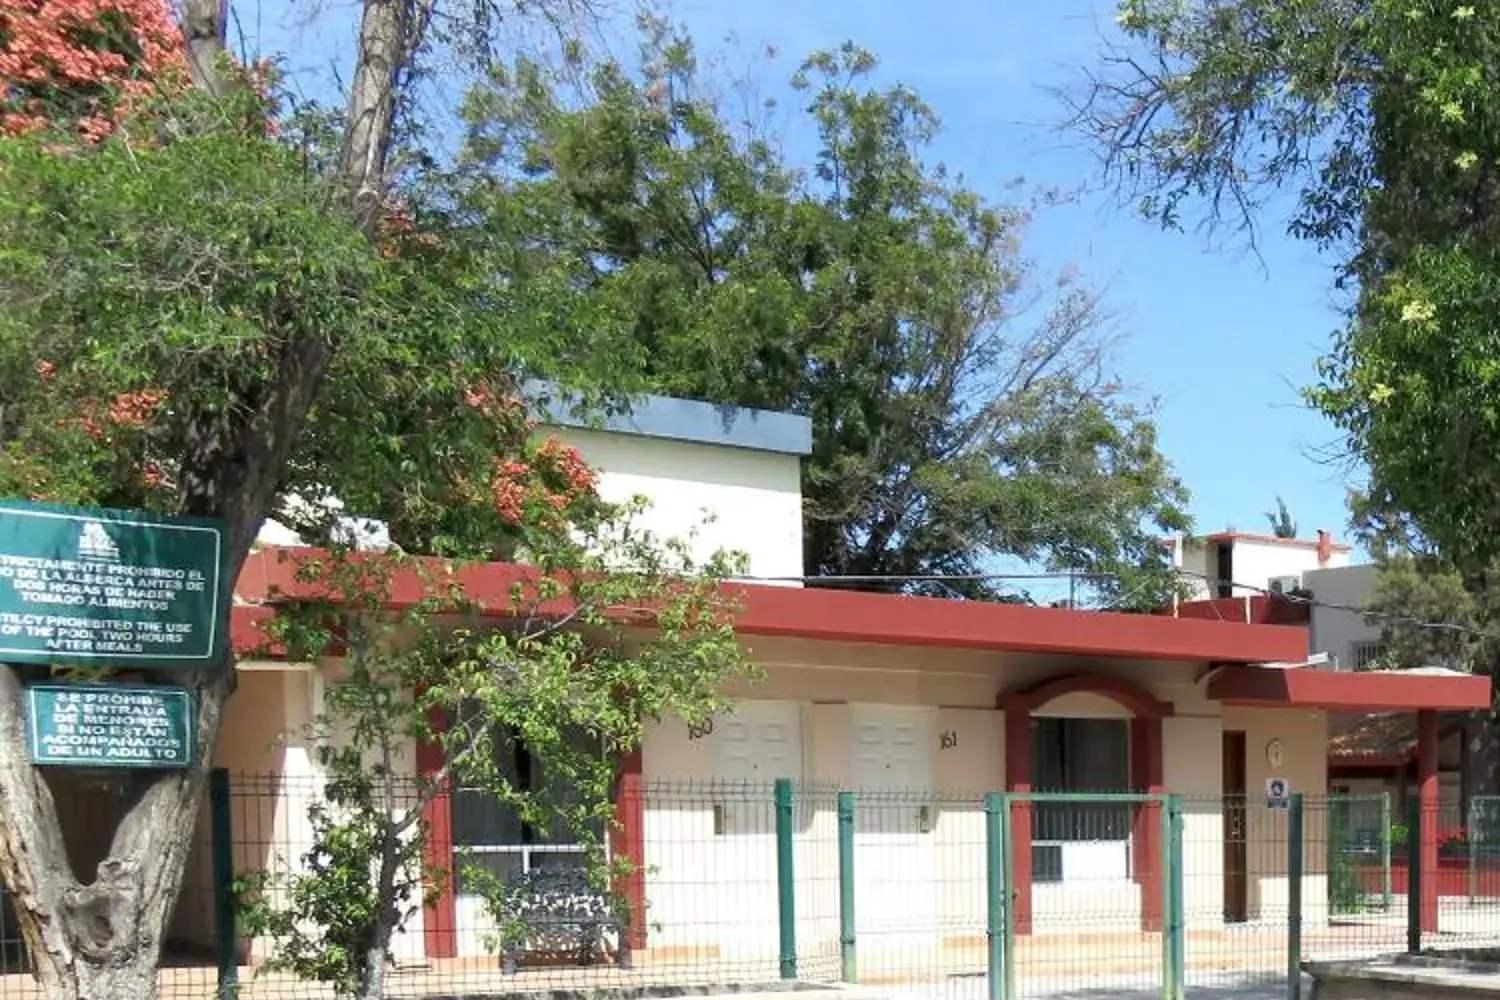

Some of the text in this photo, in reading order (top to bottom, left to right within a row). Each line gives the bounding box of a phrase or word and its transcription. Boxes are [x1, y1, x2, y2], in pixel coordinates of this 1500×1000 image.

[108, 564, 184, 579] PROHIBIDO
[188, 570, 205, 580] EL
[17, 568, 38, 579] DE
[41, 570, 61, 581] LA
[63, 571, 134, 587] ALBERCA
[138, 578, 182, 591] ANTES
[186, 581, 204, 592] DE
[14, 579, 176, 600] DOS HORAS DE HABER
[88, 597, 168, 611] ALIMENTOS
[46, 615, 133, 630] PROHIBITED
[136, 621, 162, 632] THE
[165, 623, 192, 633] USE
[2, 624, 184, 643] OF THE POOL TWO HOURS
[46, 638, 142, 653] AFTER MEALS
[56, 692, 80, 703] SE
[54, 703, 167, 717] LA ENTRADA
[53, 713, 168, 726] DE MENORES
[57, 724, 74, 734] SI
[79, 725, 105, 735] NO
[48, 745, 177, 759] DE UN ADULTO
